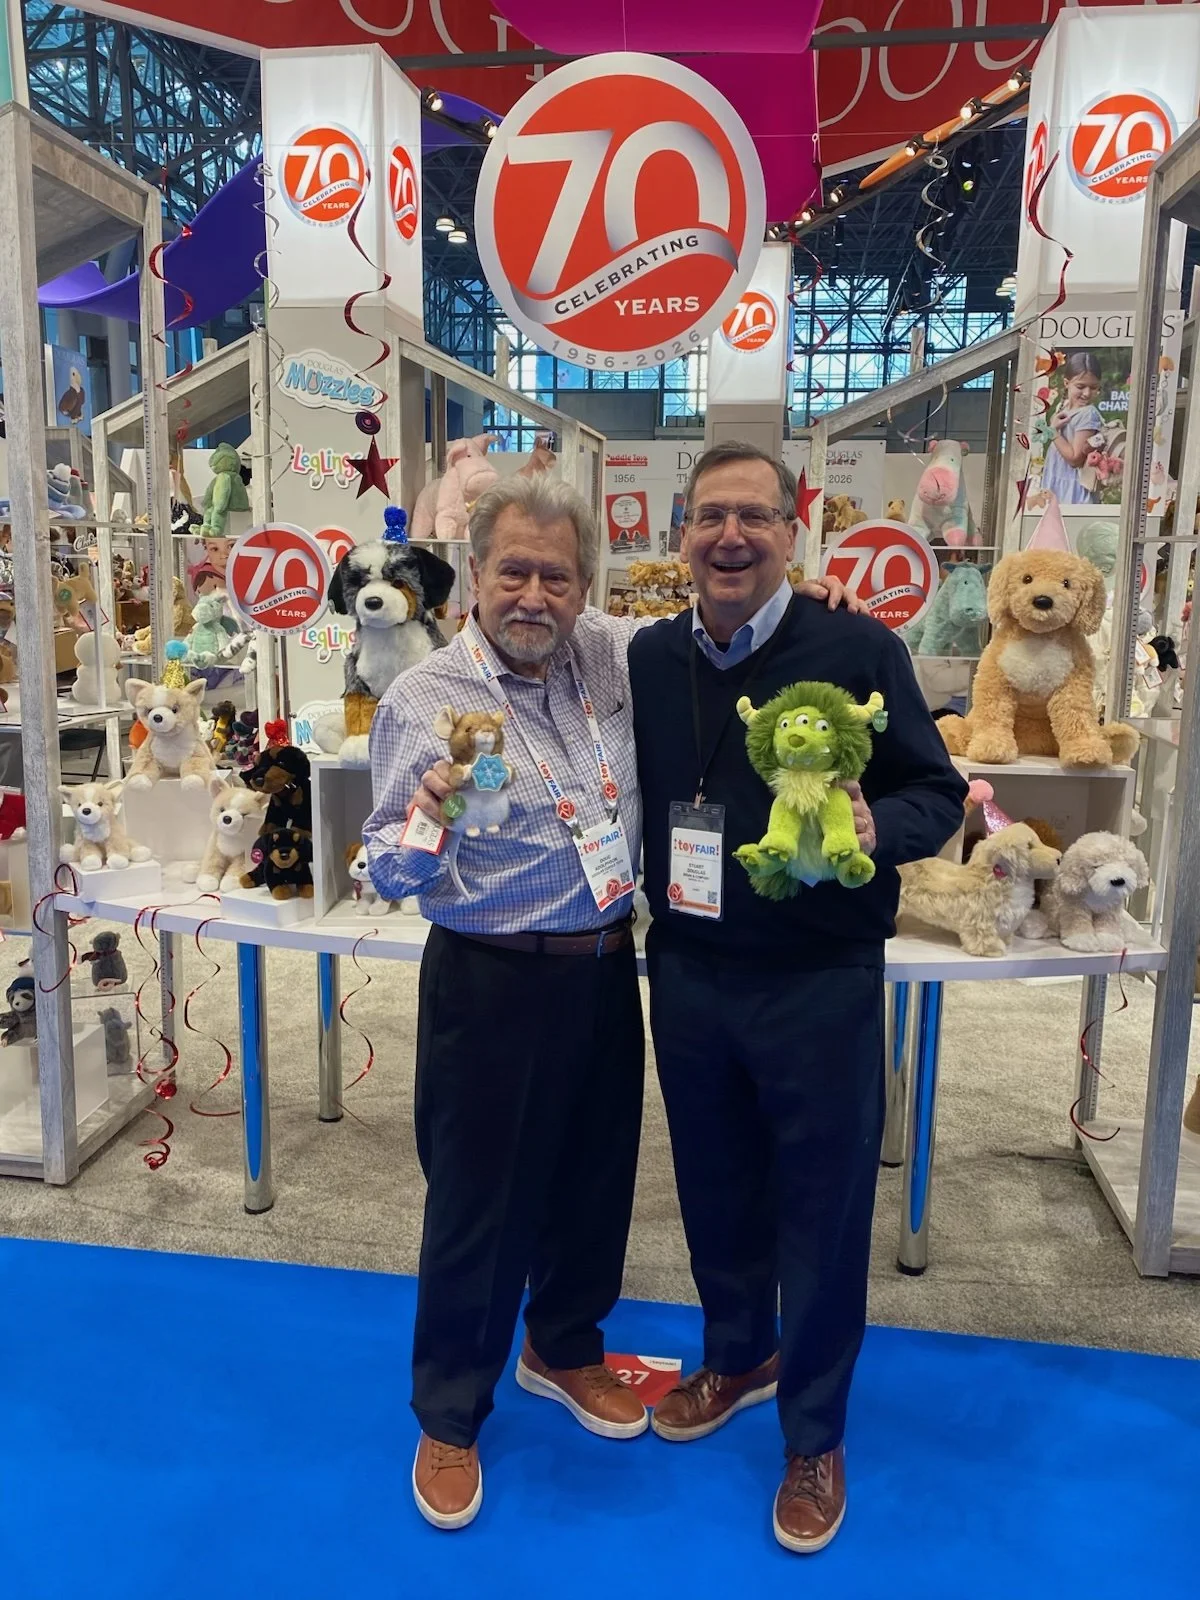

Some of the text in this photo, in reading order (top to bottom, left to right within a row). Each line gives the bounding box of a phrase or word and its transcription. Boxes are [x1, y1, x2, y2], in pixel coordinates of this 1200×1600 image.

[1078, 111, 1166, 175] 70
[284, 143, 360, 201] 70
[1091, 152, 1153, 185] CELEBRATING
[1115, 174, 1150, 185] YEARS
[301, 181, 351, 209] CELEBRATING
[321, 202, 351, 210] YEARS
[507, 120, 731, 295] 70
[554, 234, 700, 316] CELEBRATING
[614, 296, 701, 316] YEARS
[732, 301, 774, 337] 70
[1038, 314, 1176, 340] DOUGLS
[551, 329, 702, 369] 1956-2026
[825, 450, 863, 459] OUGLAS
[614, 473, 636, 484] 1956
[828, 474, 853, 484] 2026
[237, 545, 319, 605] 70
[830, 544, 925, 594] 70
[253, 589, 308, 613] CELEBRATING
[274, 608, 308, 619] YEARS
[873, 610, 910, 619] YEARS
[609, 1367, 651, 1385] 27
